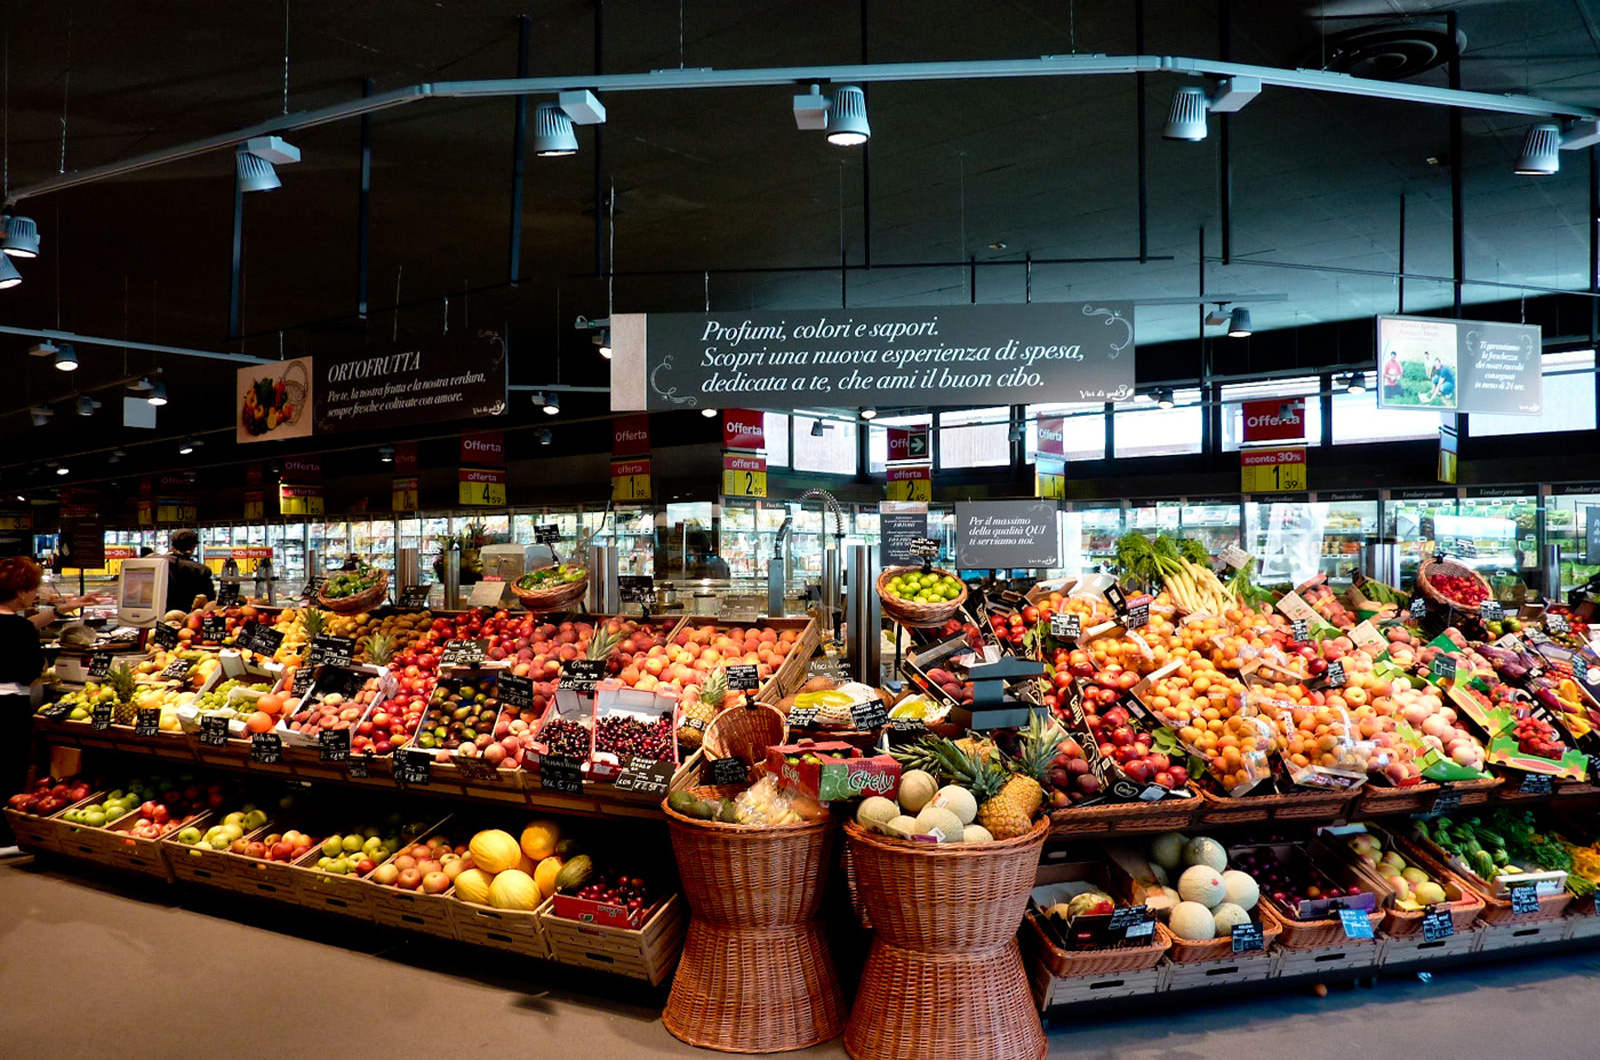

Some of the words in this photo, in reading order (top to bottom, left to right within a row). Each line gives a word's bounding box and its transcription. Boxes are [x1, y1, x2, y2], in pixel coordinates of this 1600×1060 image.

[700, 320, 786, 347] Profumi,
[793, 318, 853, 339] colori
[854, 323, 867, 337] e
[868, 316, 938, 343] sapori.
[700, 346, 767, 372] Scopri
[768, 351, 809, 366] una
[811, 349, 878, 364] nuova
[881, 342, 991, 369] esperienza
[995, 339, 1019, 361] di
[1020, 345, 1084, 366] spesa,
[327, 350, 422, 383] ORTOFRUTTA
[701, 371, 787, 393] dedicata
[791, 377, 806, 391] a
[809, 375, 831, 393] te,
[838, 369, 873, 390] che
[876, 369, 919, 389] ami
[920, 368, 937, 389] il
[938, 367, 992, 389] buon
[996, 366, 1044, 387] cibo.
[327, 390, 341, 403] Per
[350, 387, 359, 400] la
[359, 387, 384, 398] nostra
[381, 382, 407, 399] frutta
[406, 383, 413, 392] e
[412, 378, 422, 391] la
[422, 377, 449, 390] nostra
[326, 406, 353, 420] sempre
[350, 399, 379, 418] fresche
[379, 402, 385, 411] e
[384, 396, 418, 410] coltivate
[417, 396, 433, 406] con
[615, 430, 648, 442] Offerta
[727, 422, 762, 436] Offerta
[1038, 428, 1062, 442] Offerta
[463, 439, 502, 453] Offerta
[1245, 455, 1276, 463] sconto
[1276, 451, 1302, 462] 30%
[284, 461, 320, 471] Offerta
[617, 465, 643, 474] offerta
[731, 460, 760, 470] offerta
[467, 473, 497, 482] offerta
[893, 469, 922, 479] offerta
[1272, 465, 1280, 490] 1
[1284, 480, 1298, 489] 39
[629, 476, 635, 498] 1
[745, 471, 753, 495] 2
[288, 488, 317, 496] offerta
[482, 483, 490, 503] 4
[906, 481, 915, 502] 2
[968, 515, 985, 526] Per
[985, 515, 993, 525] il
[992, 516, 1031, 525] massimo
[968, 526, 991, 536] della
[992, 525, 1024, 538] qualità
[1025, 525, 1047, 537] QUI
[969, 536, 977, 545] ti
[976, 536, 1017, 545] serviamo
[1017, 536, 1035, 545] noi.
